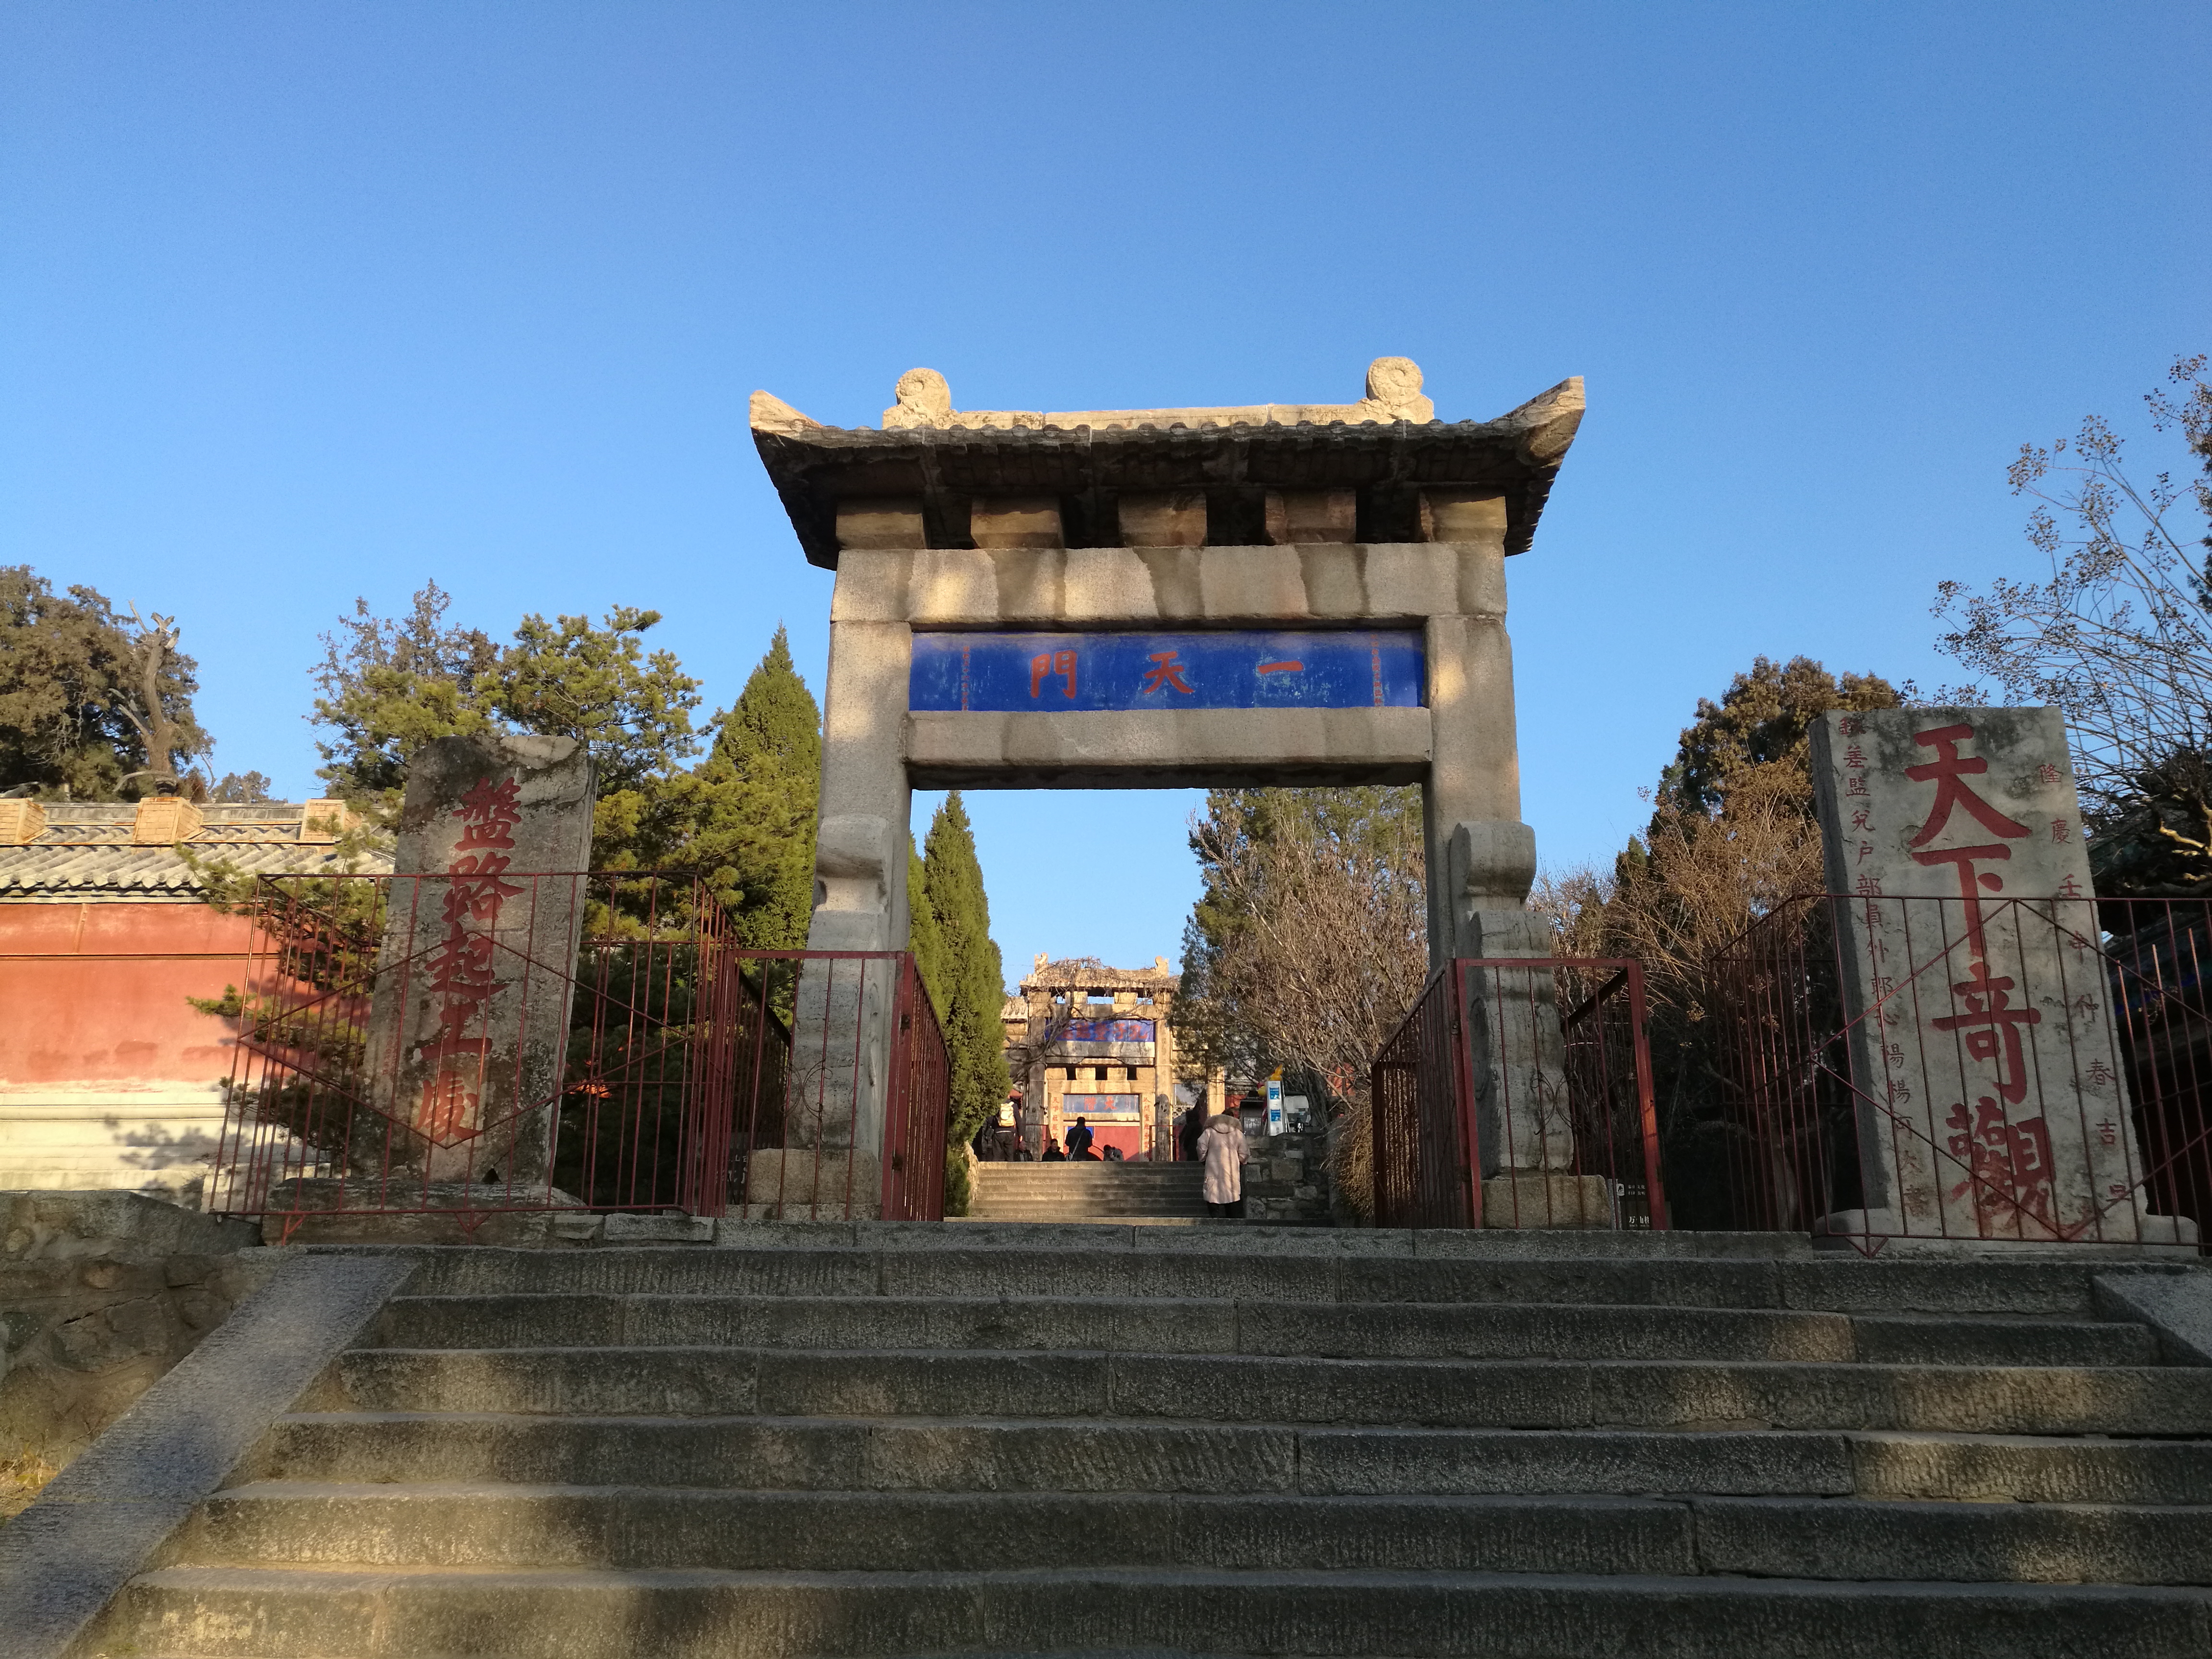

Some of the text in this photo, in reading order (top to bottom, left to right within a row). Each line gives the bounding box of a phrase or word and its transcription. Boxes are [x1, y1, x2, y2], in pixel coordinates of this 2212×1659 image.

[1029, 649, 1303, 699] 一天門
[1905, 723, 2081, 1237] 天下奇觀
